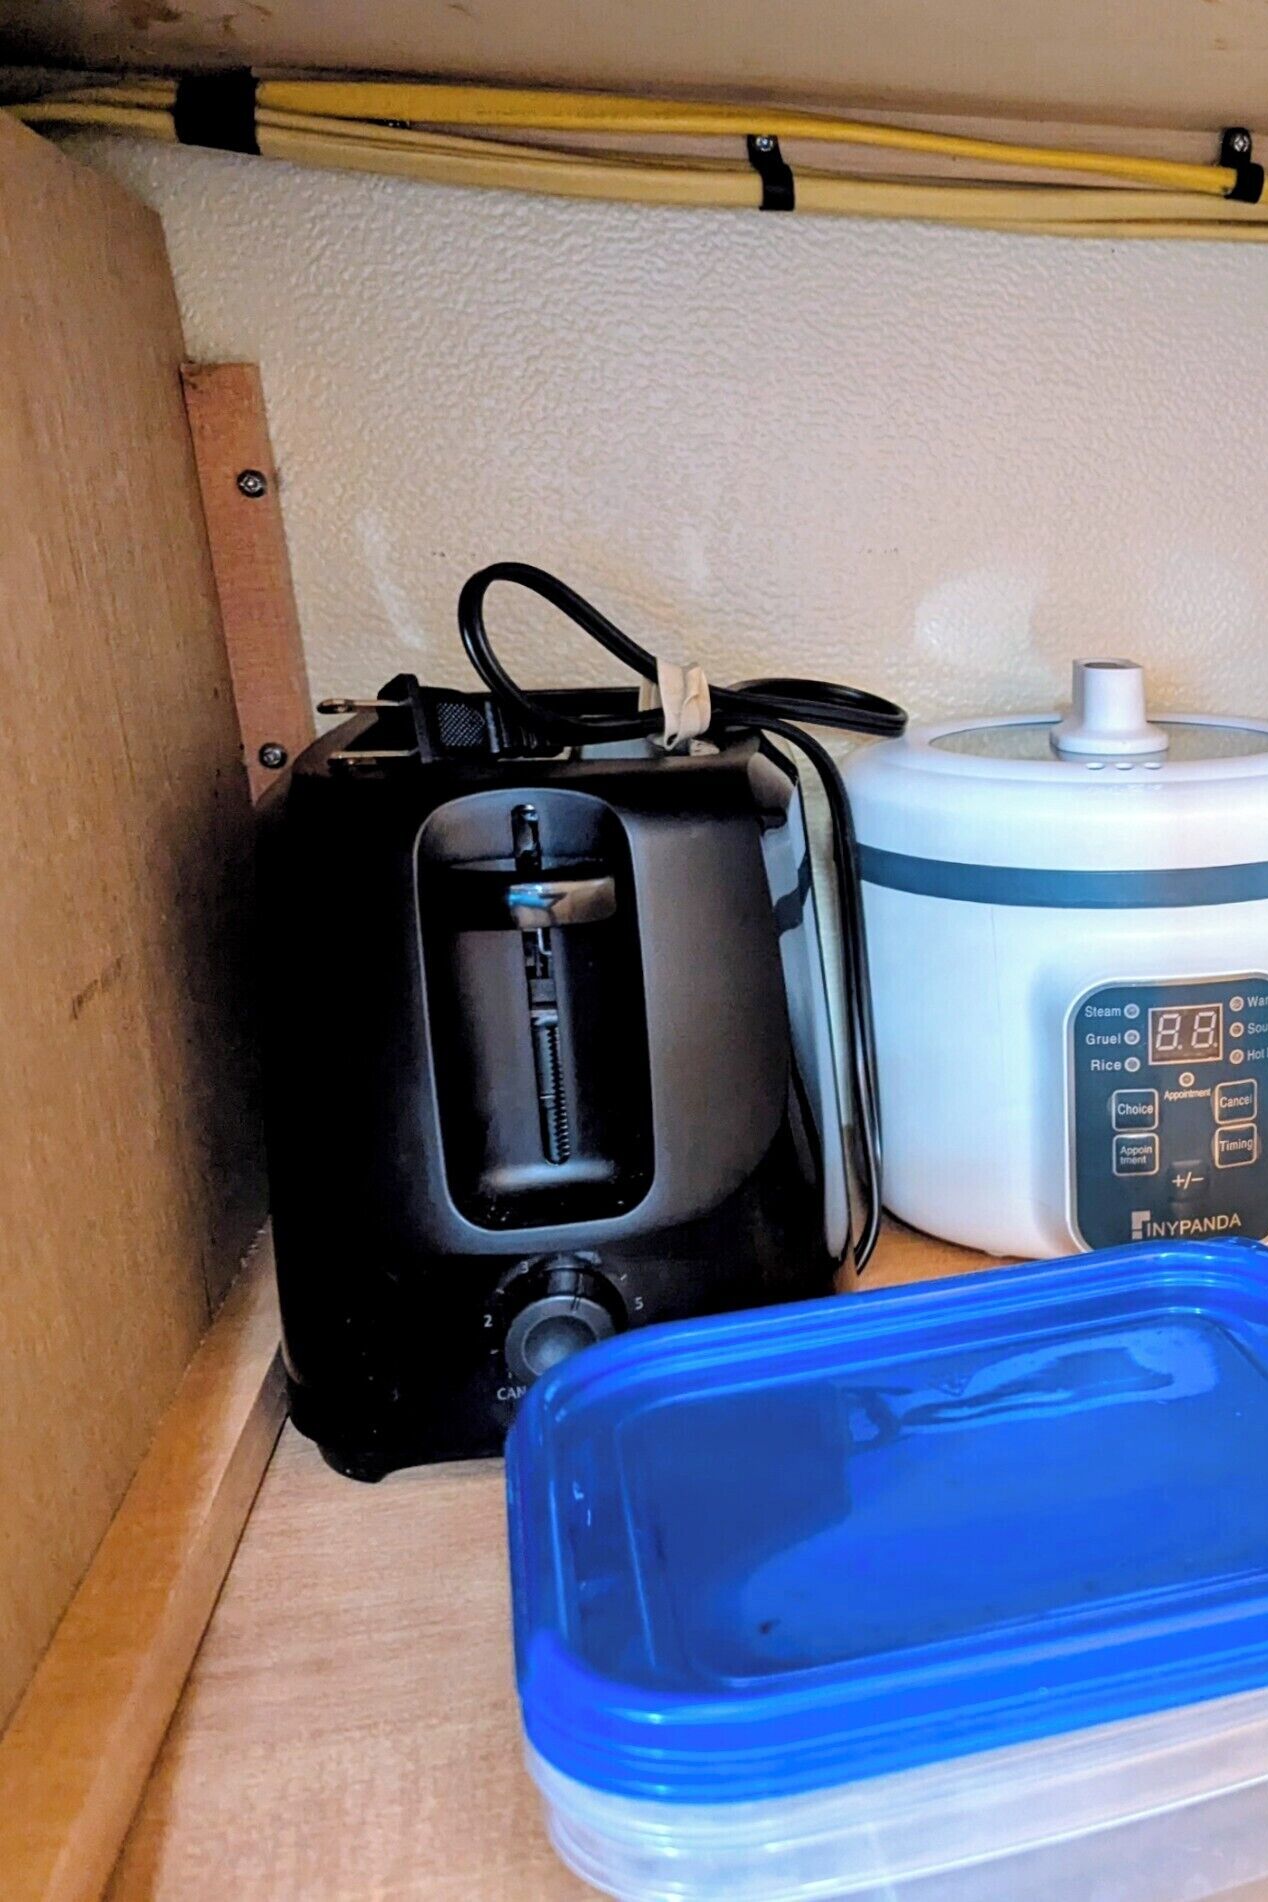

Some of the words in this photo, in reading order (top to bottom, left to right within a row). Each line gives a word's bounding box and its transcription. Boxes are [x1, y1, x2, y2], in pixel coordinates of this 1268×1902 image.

[1084, 1005, 1122, 1018] Steam
[1085, 1032, 1122, 1046] Gruel
[1247, 1048, 1265, 1061] Hot
[1090, 1059, 1122, 1071] Rice
[1164, 1088, 1212, 1101] Appointment
[1117, 1103, 1154, 1116] Choice
[1219, 1138, 1253, 1152] Timing
[520, 1261, 529, 1273] 3
[635, 1297, 644, 1310] 5
[484, 1315, 493, 1327] 2
